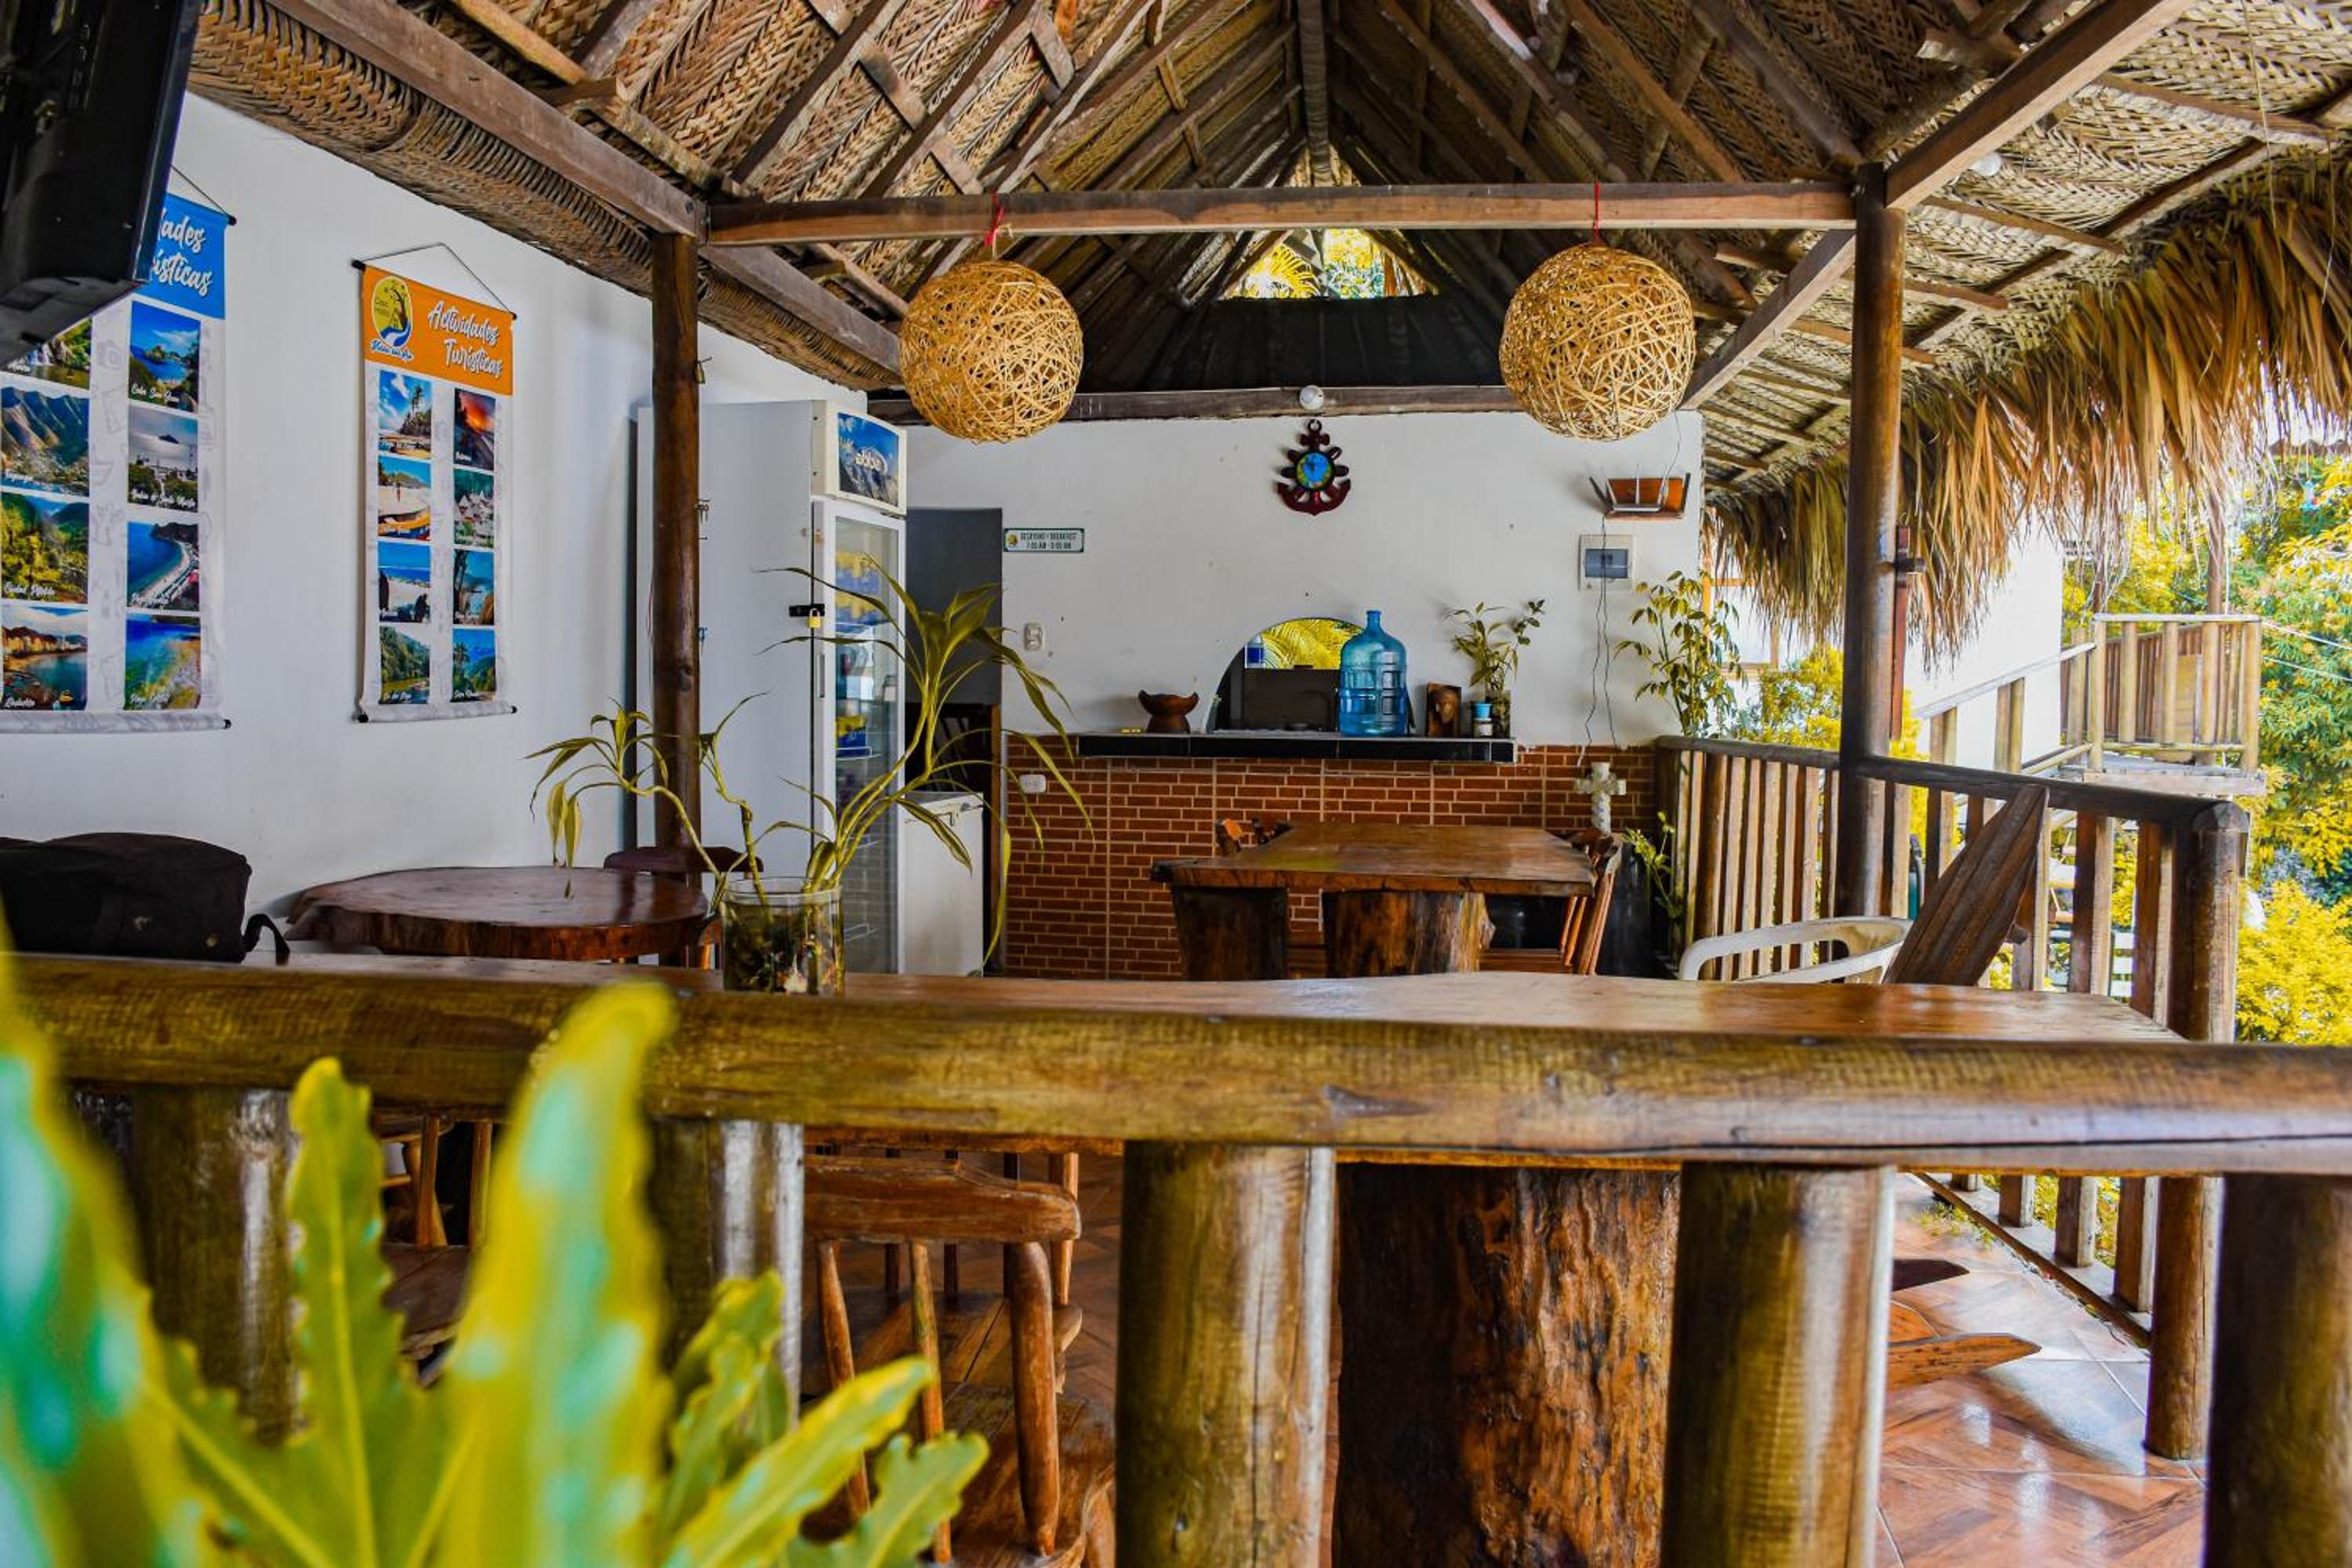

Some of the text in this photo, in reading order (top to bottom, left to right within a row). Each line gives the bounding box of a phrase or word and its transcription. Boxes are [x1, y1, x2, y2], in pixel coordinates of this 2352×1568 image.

[158, 207, 207, 254] ades
[151, 248, 214, 297] ísticas
[428, 300, 499, 346] Actividades
[445, 338, 503, 379] Turísticas
